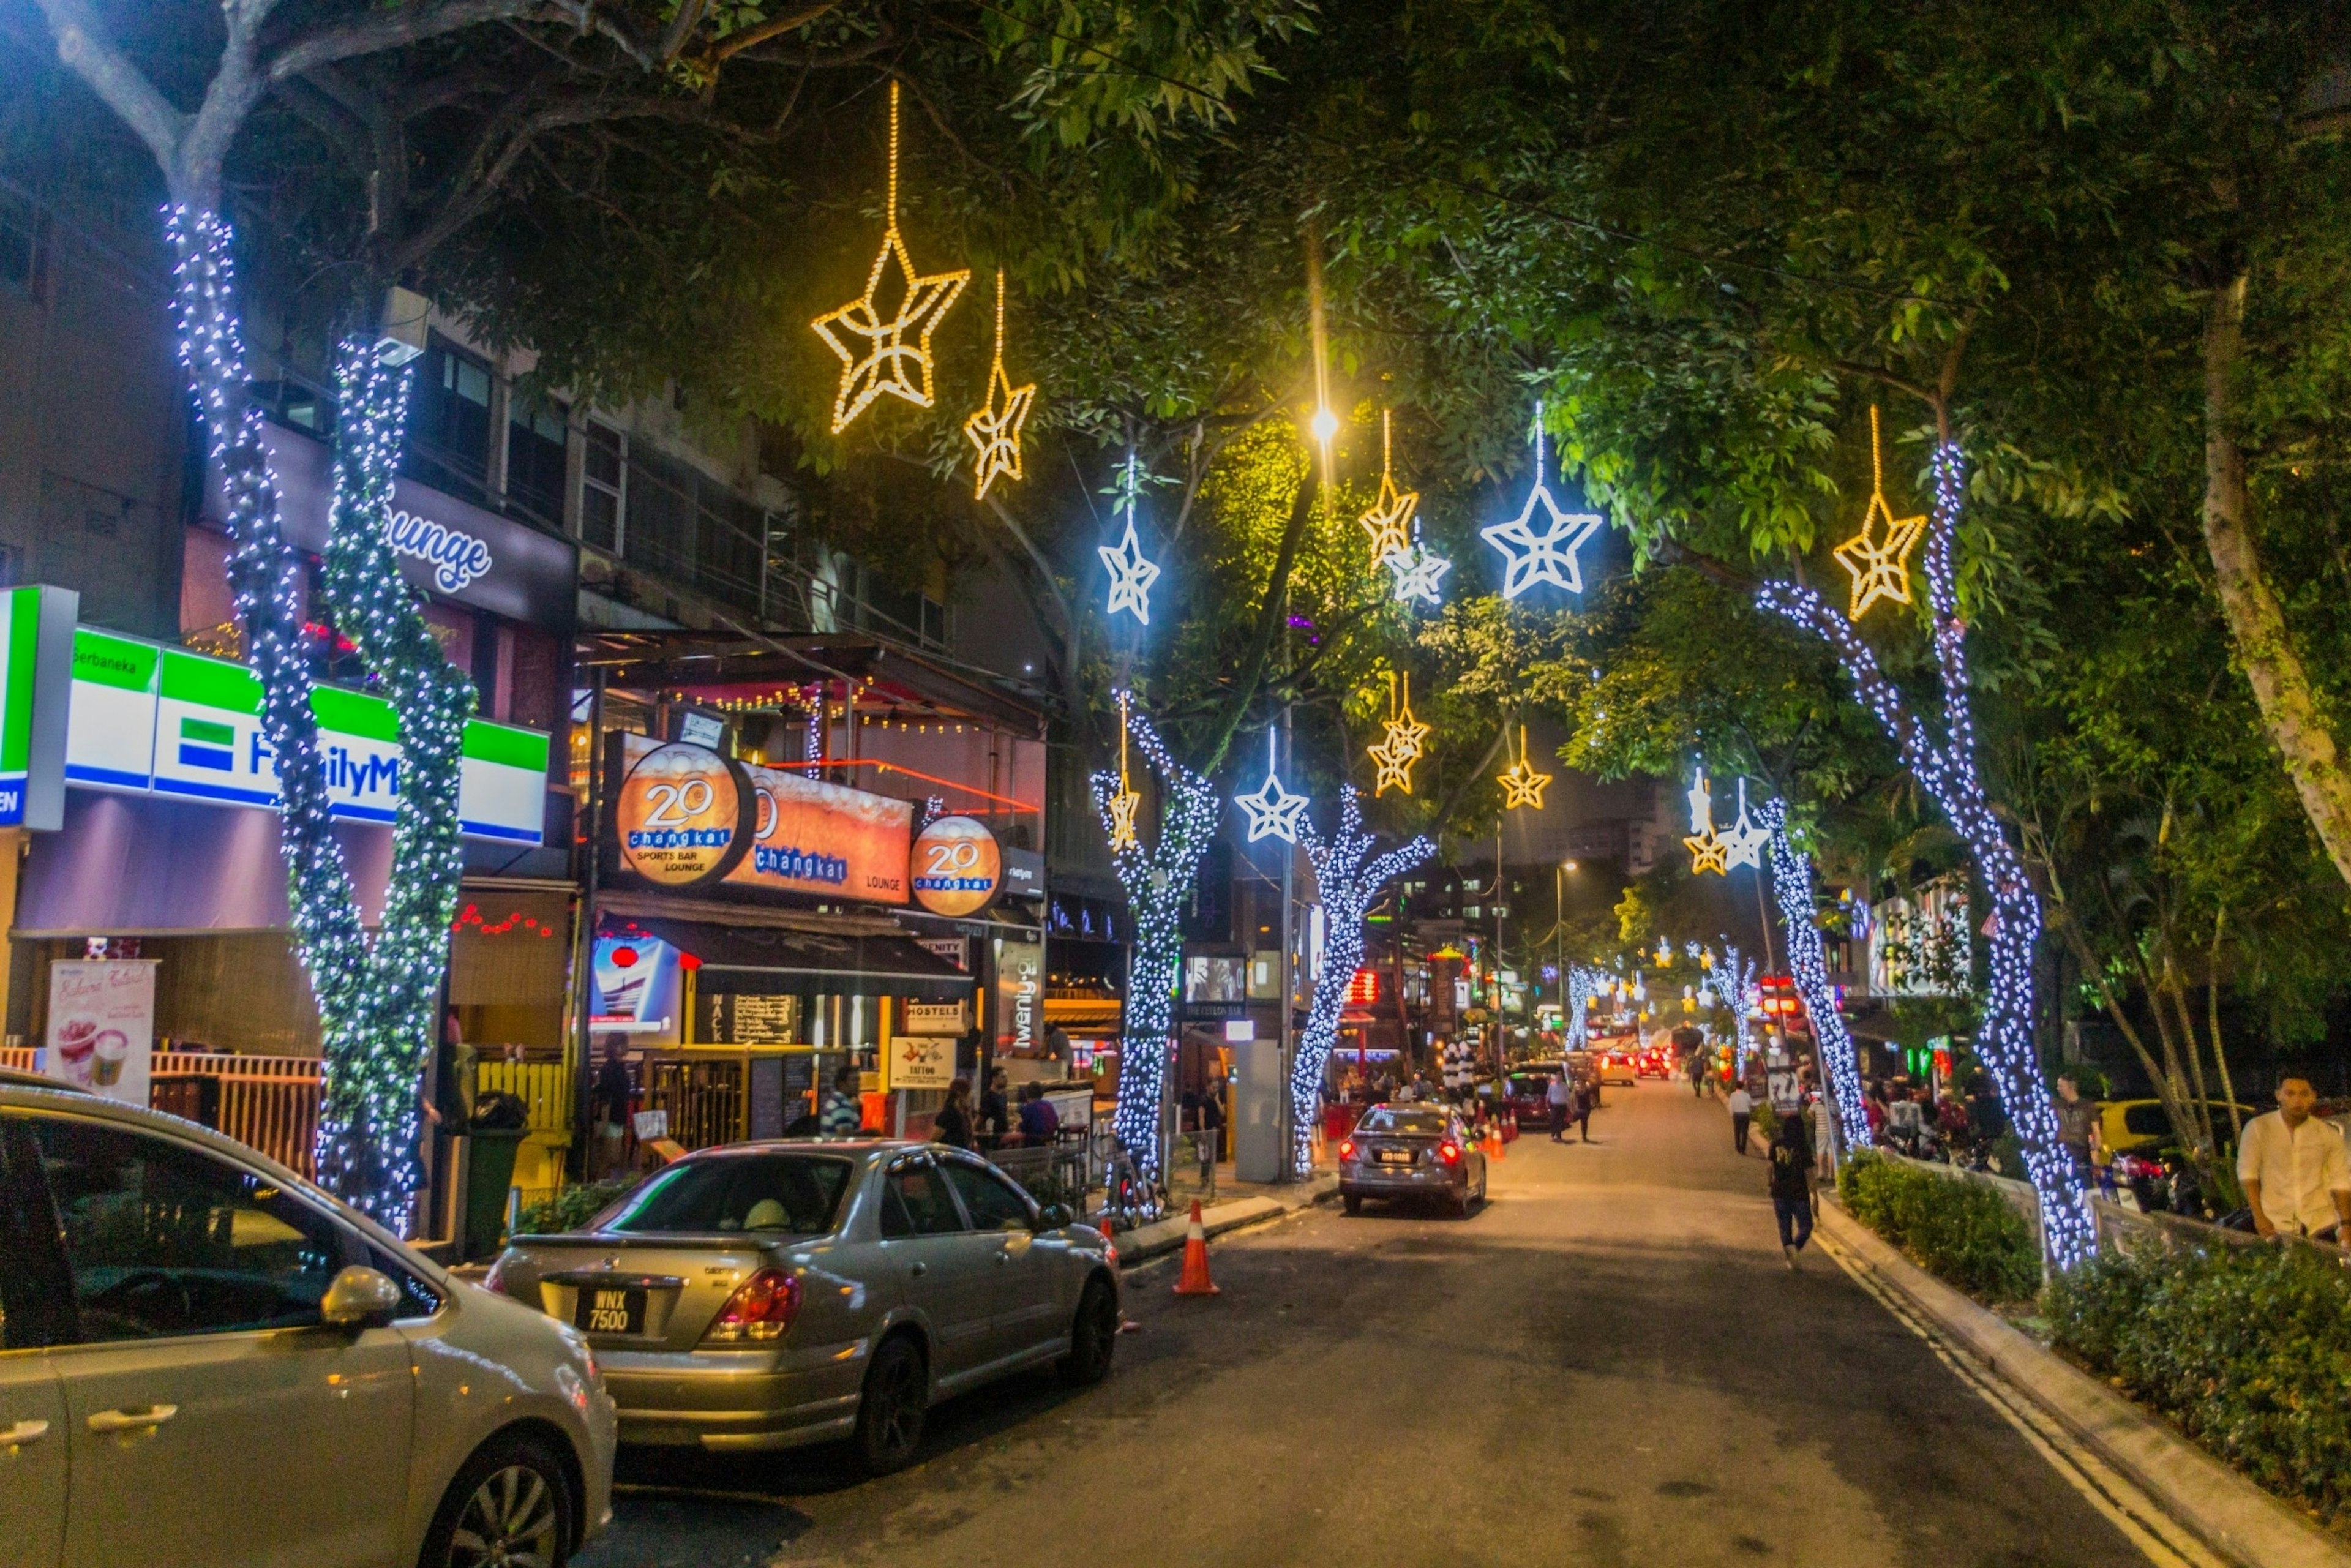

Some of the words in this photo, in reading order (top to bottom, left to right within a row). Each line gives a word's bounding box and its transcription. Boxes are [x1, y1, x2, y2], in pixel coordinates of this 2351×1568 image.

[645, 778, 714, 827] 20
[629, 831, 726, 846] changkat
[637, 852, 675, 860] SPORTS
[678, 852, 697, 860] BAR
[926, 841, 979, 876] 20
[664, 863, 705, 872] LOUNGE
[756, 849, 844, 880] changkat
[866, 876, 901, 891] LOUNGE
[915, 878, 989, 890] changkat
[908, 1007, 959, 1016] HOSTELS
[910, 1065, 936, 1075] TATTOO
[595, 1290, 627, 1310] WNX
[589, 1309, 629, 1330] 7500
